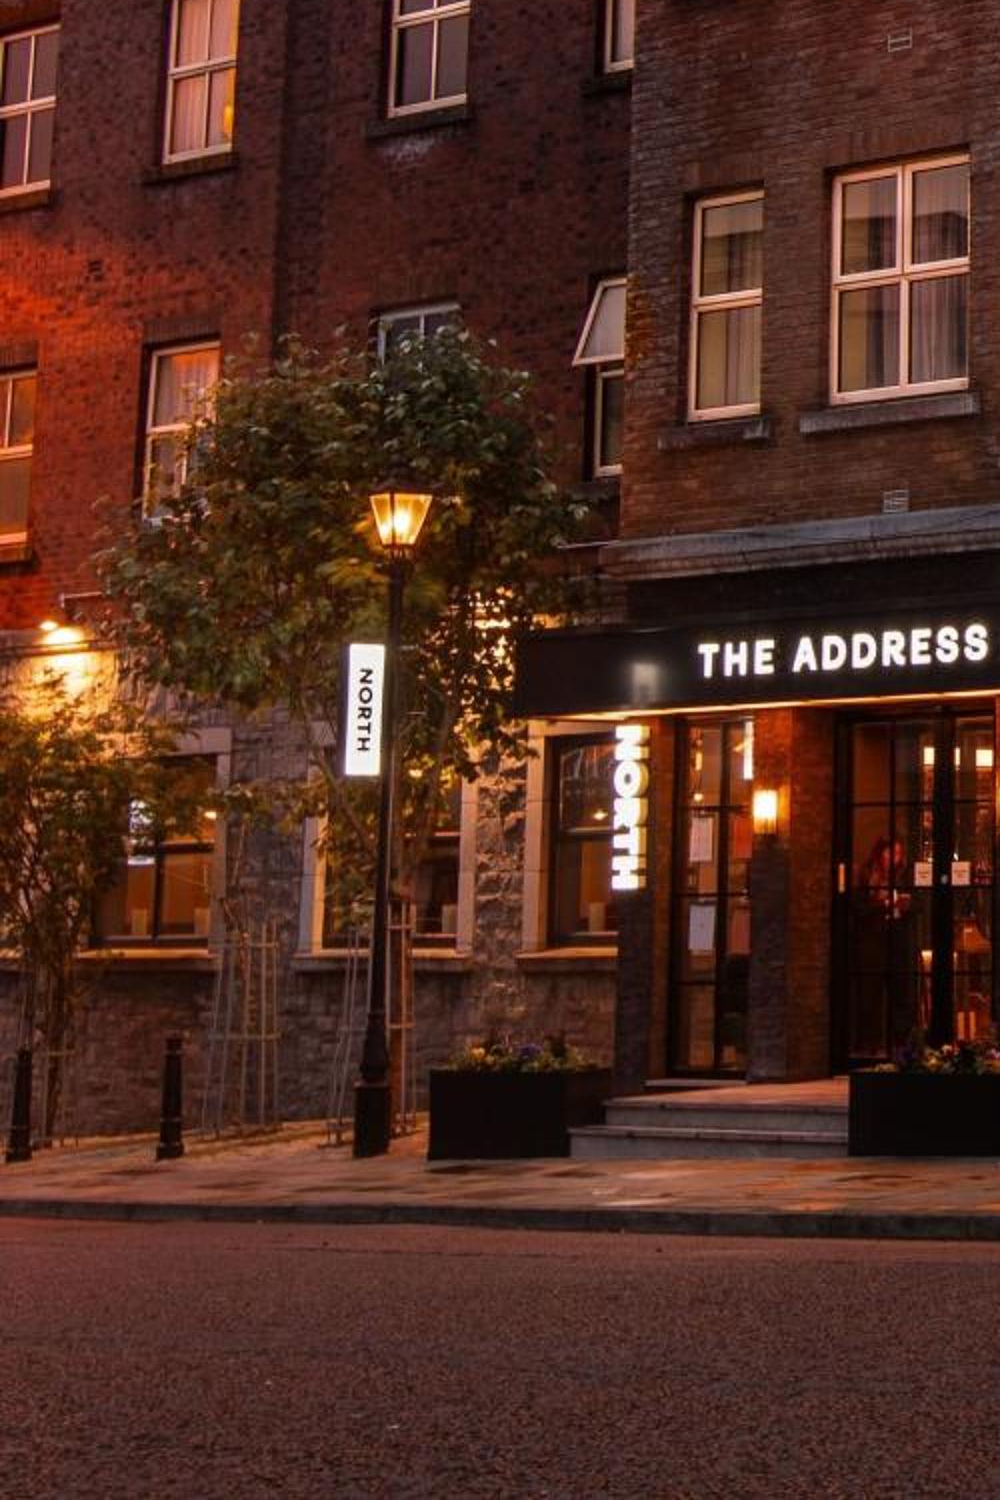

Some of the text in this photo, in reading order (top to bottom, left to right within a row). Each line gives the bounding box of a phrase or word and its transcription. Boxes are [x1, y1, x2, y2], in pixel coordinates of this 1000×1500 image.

[697, 622, 990, 679] THE ADDRESS
[356, 668, 374, 752] NORTH
[611, 724, 649, 890] NORTH
